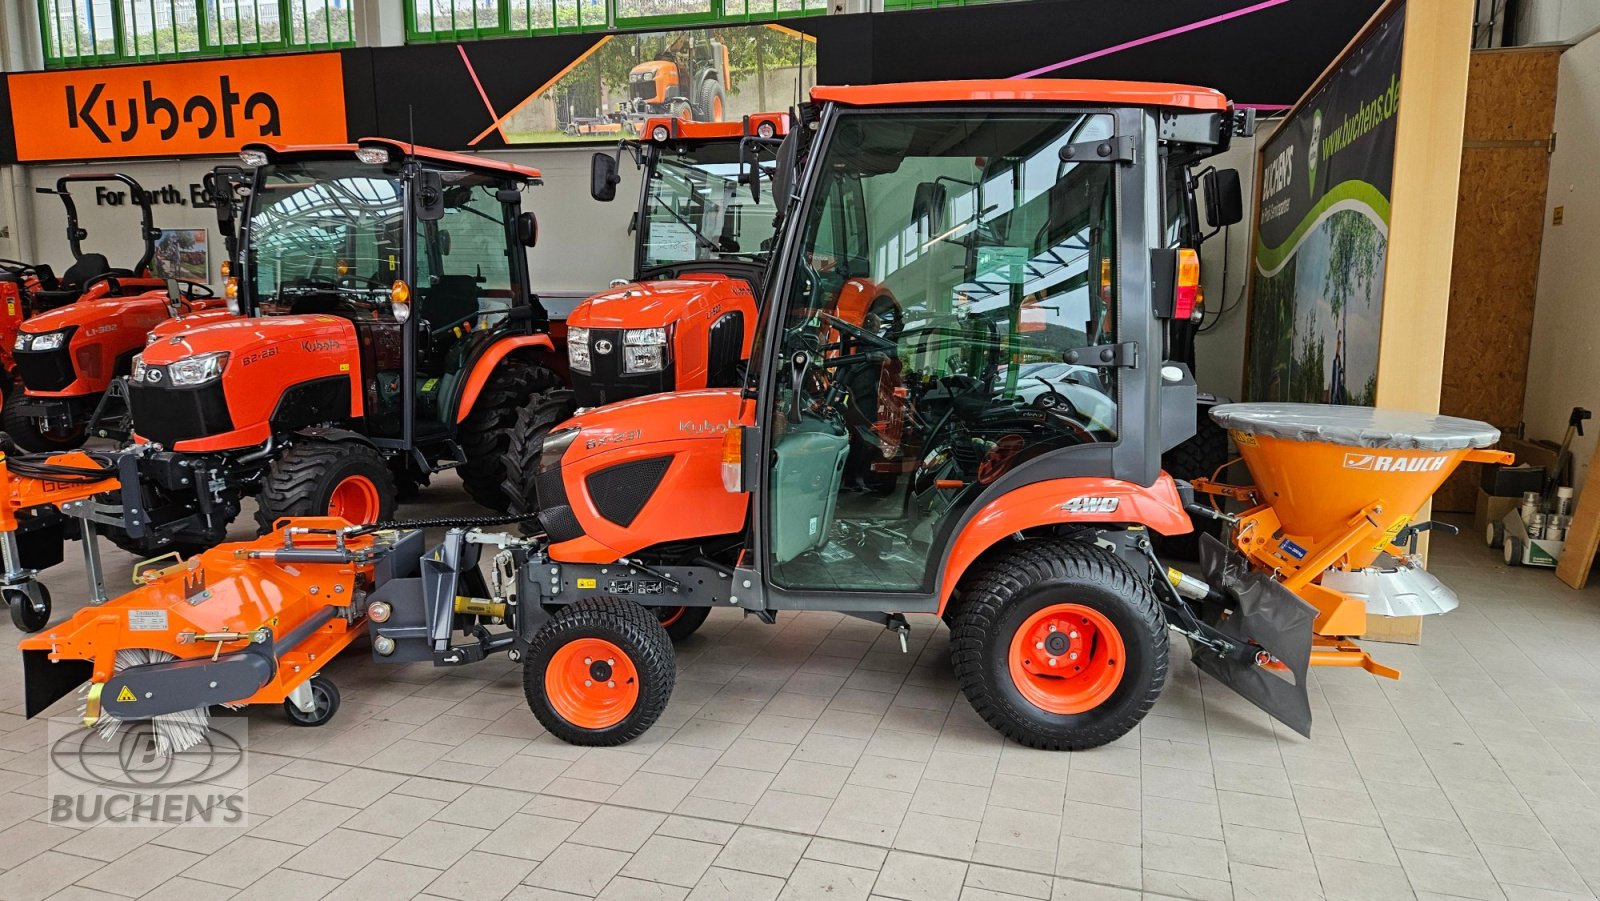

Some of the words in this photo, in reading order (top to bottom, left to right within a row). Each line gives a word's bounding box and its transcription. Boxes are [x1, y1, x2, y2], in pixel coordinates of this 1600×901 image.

[65, 75, 282, 143] Kubota
[95, 186, 125, 206] For
[301, 338, 341, 352] Kubota
[679, 419, 741, 435] Kubot
[1374, 456, 1448, 472] RAUCH
[1060, 496, 1120, 513] 4WD
